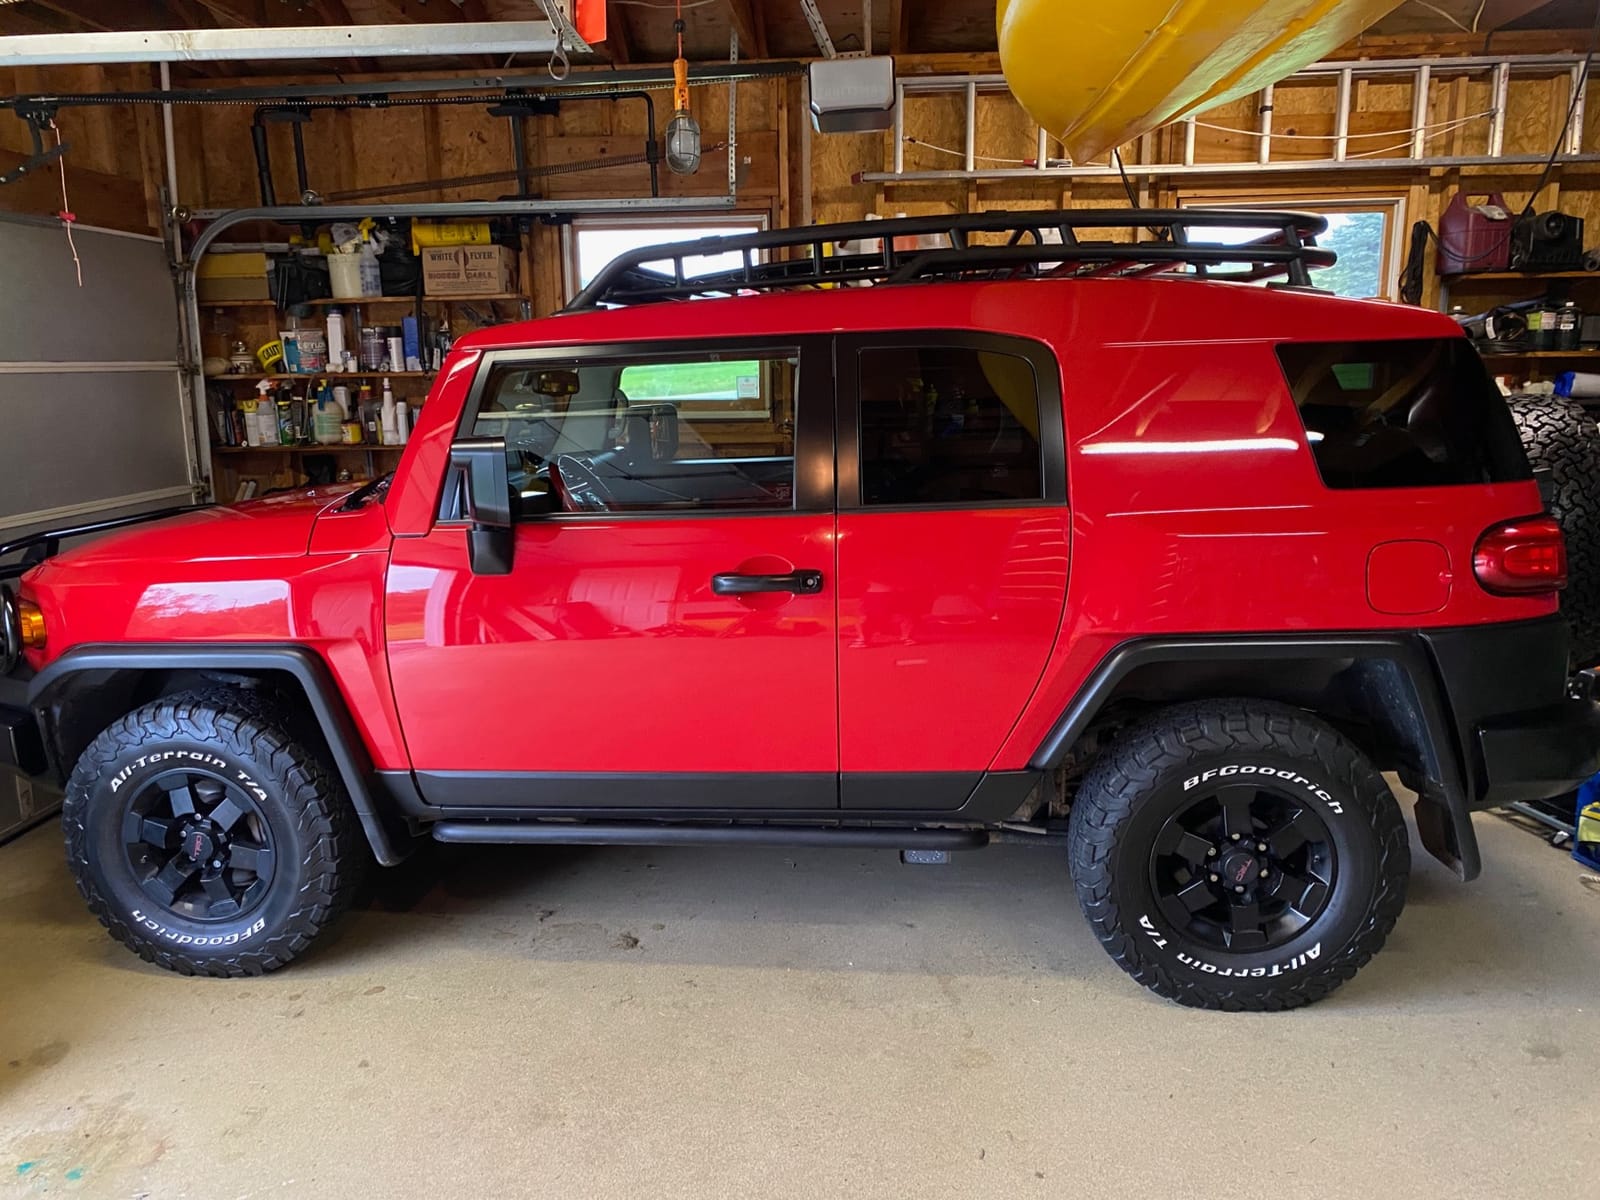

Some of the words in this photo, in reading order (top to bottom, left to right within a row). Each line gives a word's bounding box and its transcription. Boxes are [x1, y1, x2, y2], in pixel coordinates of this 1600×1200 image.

[430, 252, 453, 261] WHITE
[110, 750, 227, 793] All-Terrain
[237, 769, 268, 801] T/A
[1183, 764, 1344, 815] BFGoodrich
[132, 909, 266, 945] BFGoodrich
[1139, 914, 1169, 950] T/A
[1176, 942, 1321, 978] All-Terrain
